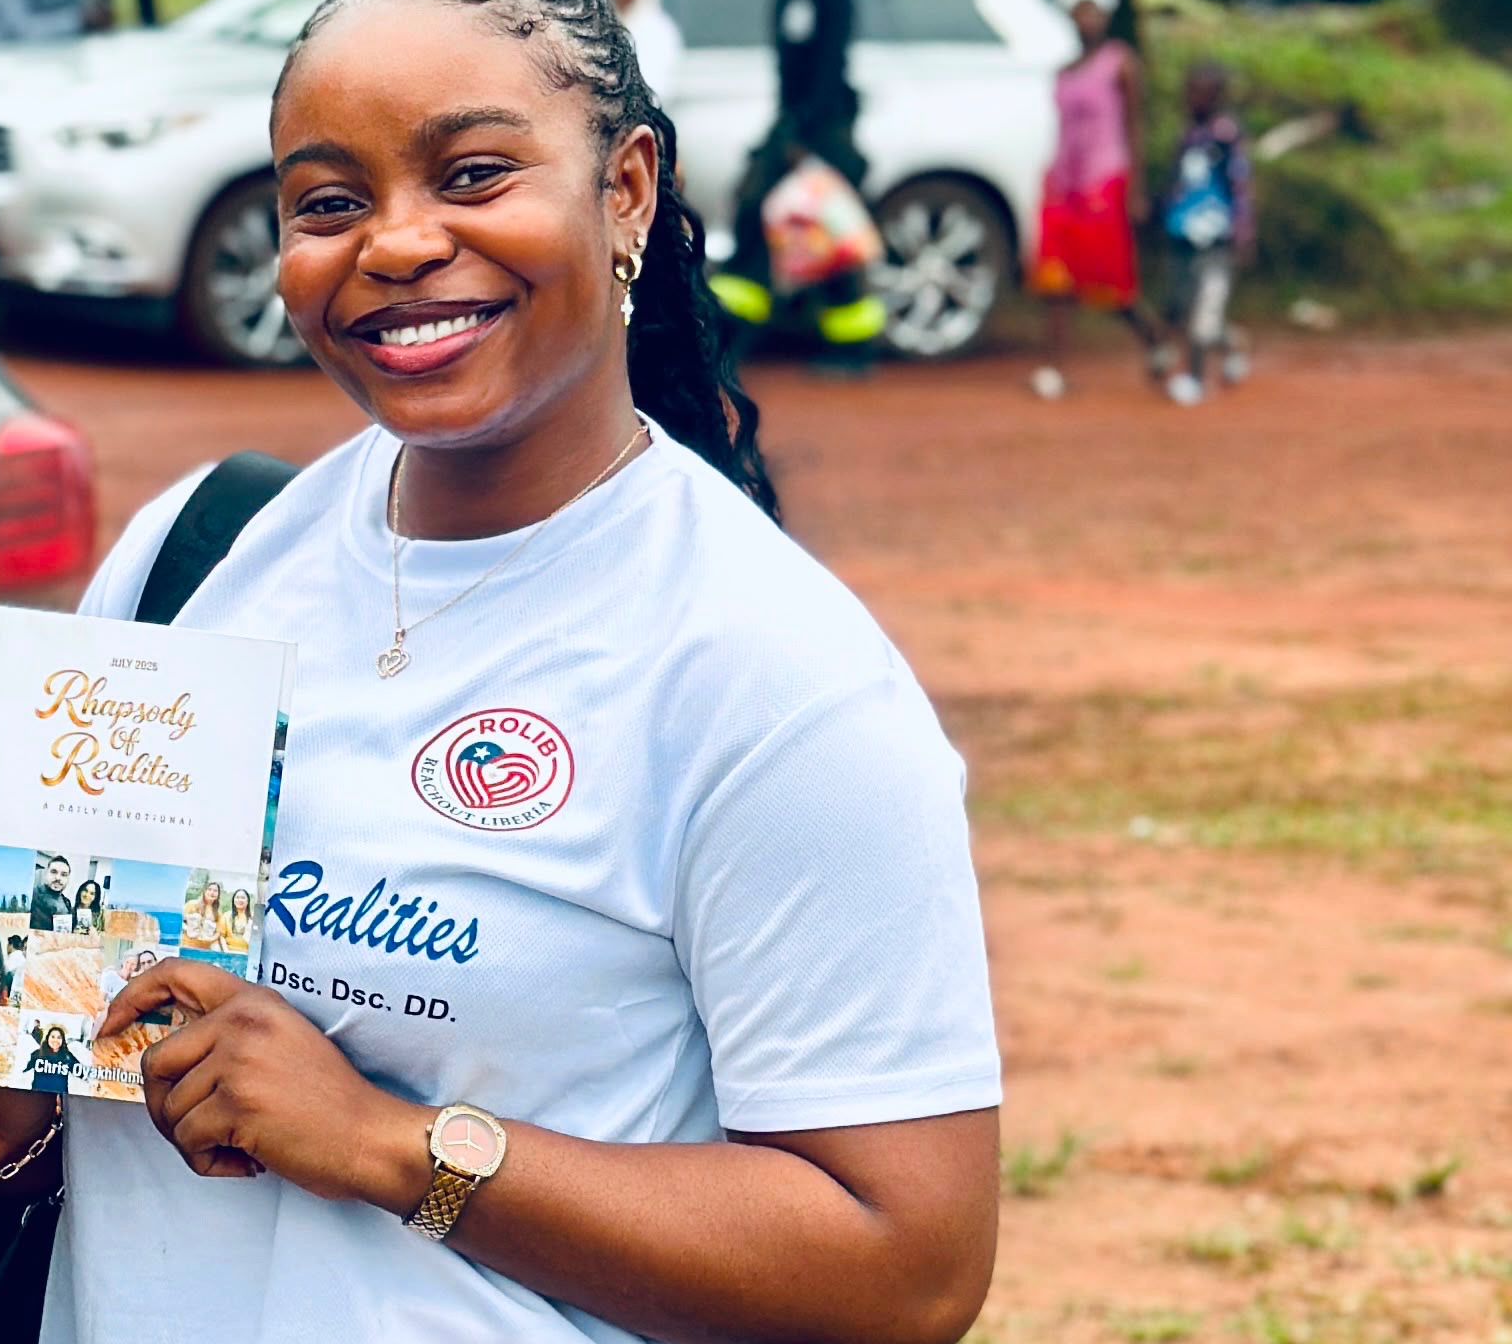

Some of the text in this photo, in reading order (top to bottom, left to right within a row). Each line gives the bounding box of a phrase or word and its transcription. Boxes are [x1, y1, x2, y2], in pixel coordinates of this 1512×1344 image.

[109, 657, 133, 668] JULY
[35, 669, 197, 741] Rhapsody
[109, 727, 140, 756] Of
[479, 717, 558, 757] ROLIB
[40, 732, 192, 796] Realities
[58, 804, 98, 816] DAILY
[421, 757, 552, 826] REACHOUT LIBERIA
[265, 860, 478, 964] Realities
[271, 962, 322, 996] Dsc.
[331, 978, 392, 1012] Dsc.
[404, 994, 456, 1022] DD.
[34, 1059, 68, 1075] Chris
